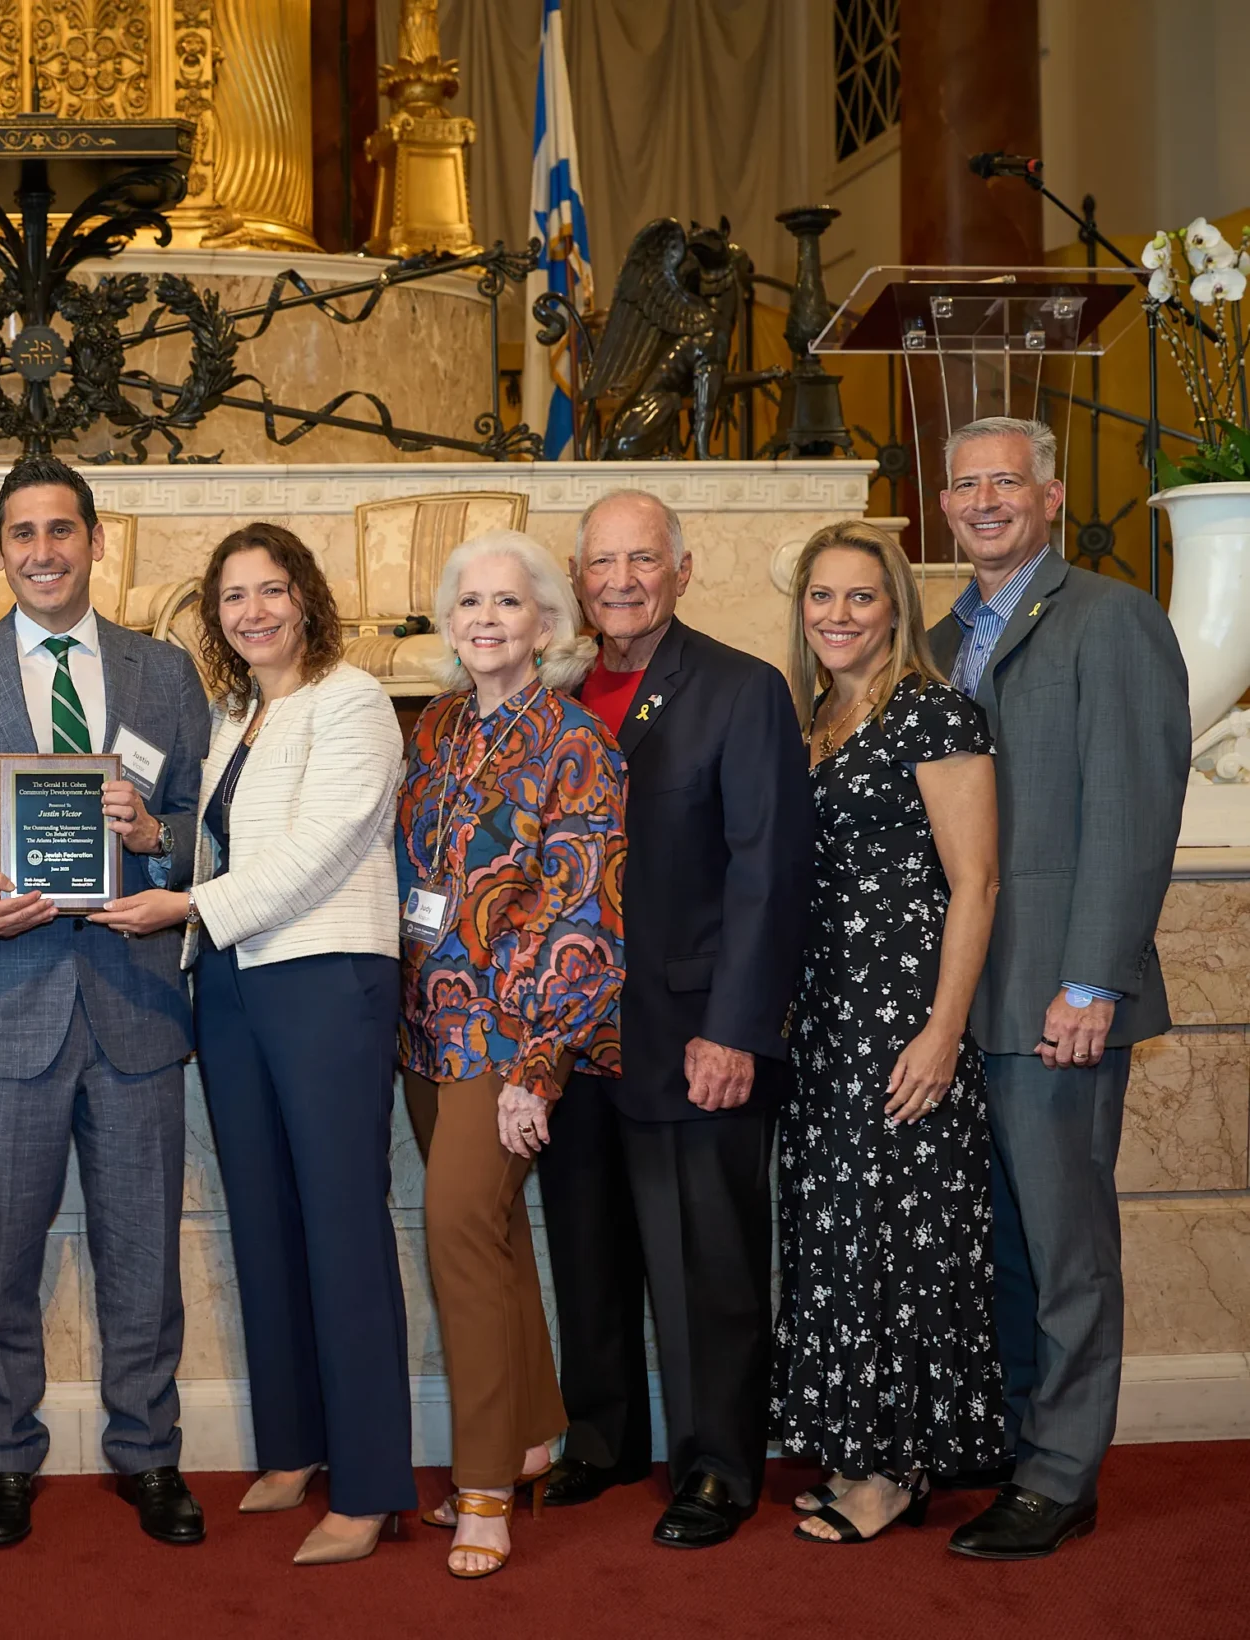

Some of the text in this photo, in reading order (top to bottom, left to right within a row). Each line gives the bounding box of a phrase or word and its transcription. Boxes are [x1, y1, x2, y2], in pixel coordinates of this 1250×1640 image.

[24, 339, 52, 351] אני
[20, 353, 59, 365] יהוה
[133, 751, 150, 766] Justin
